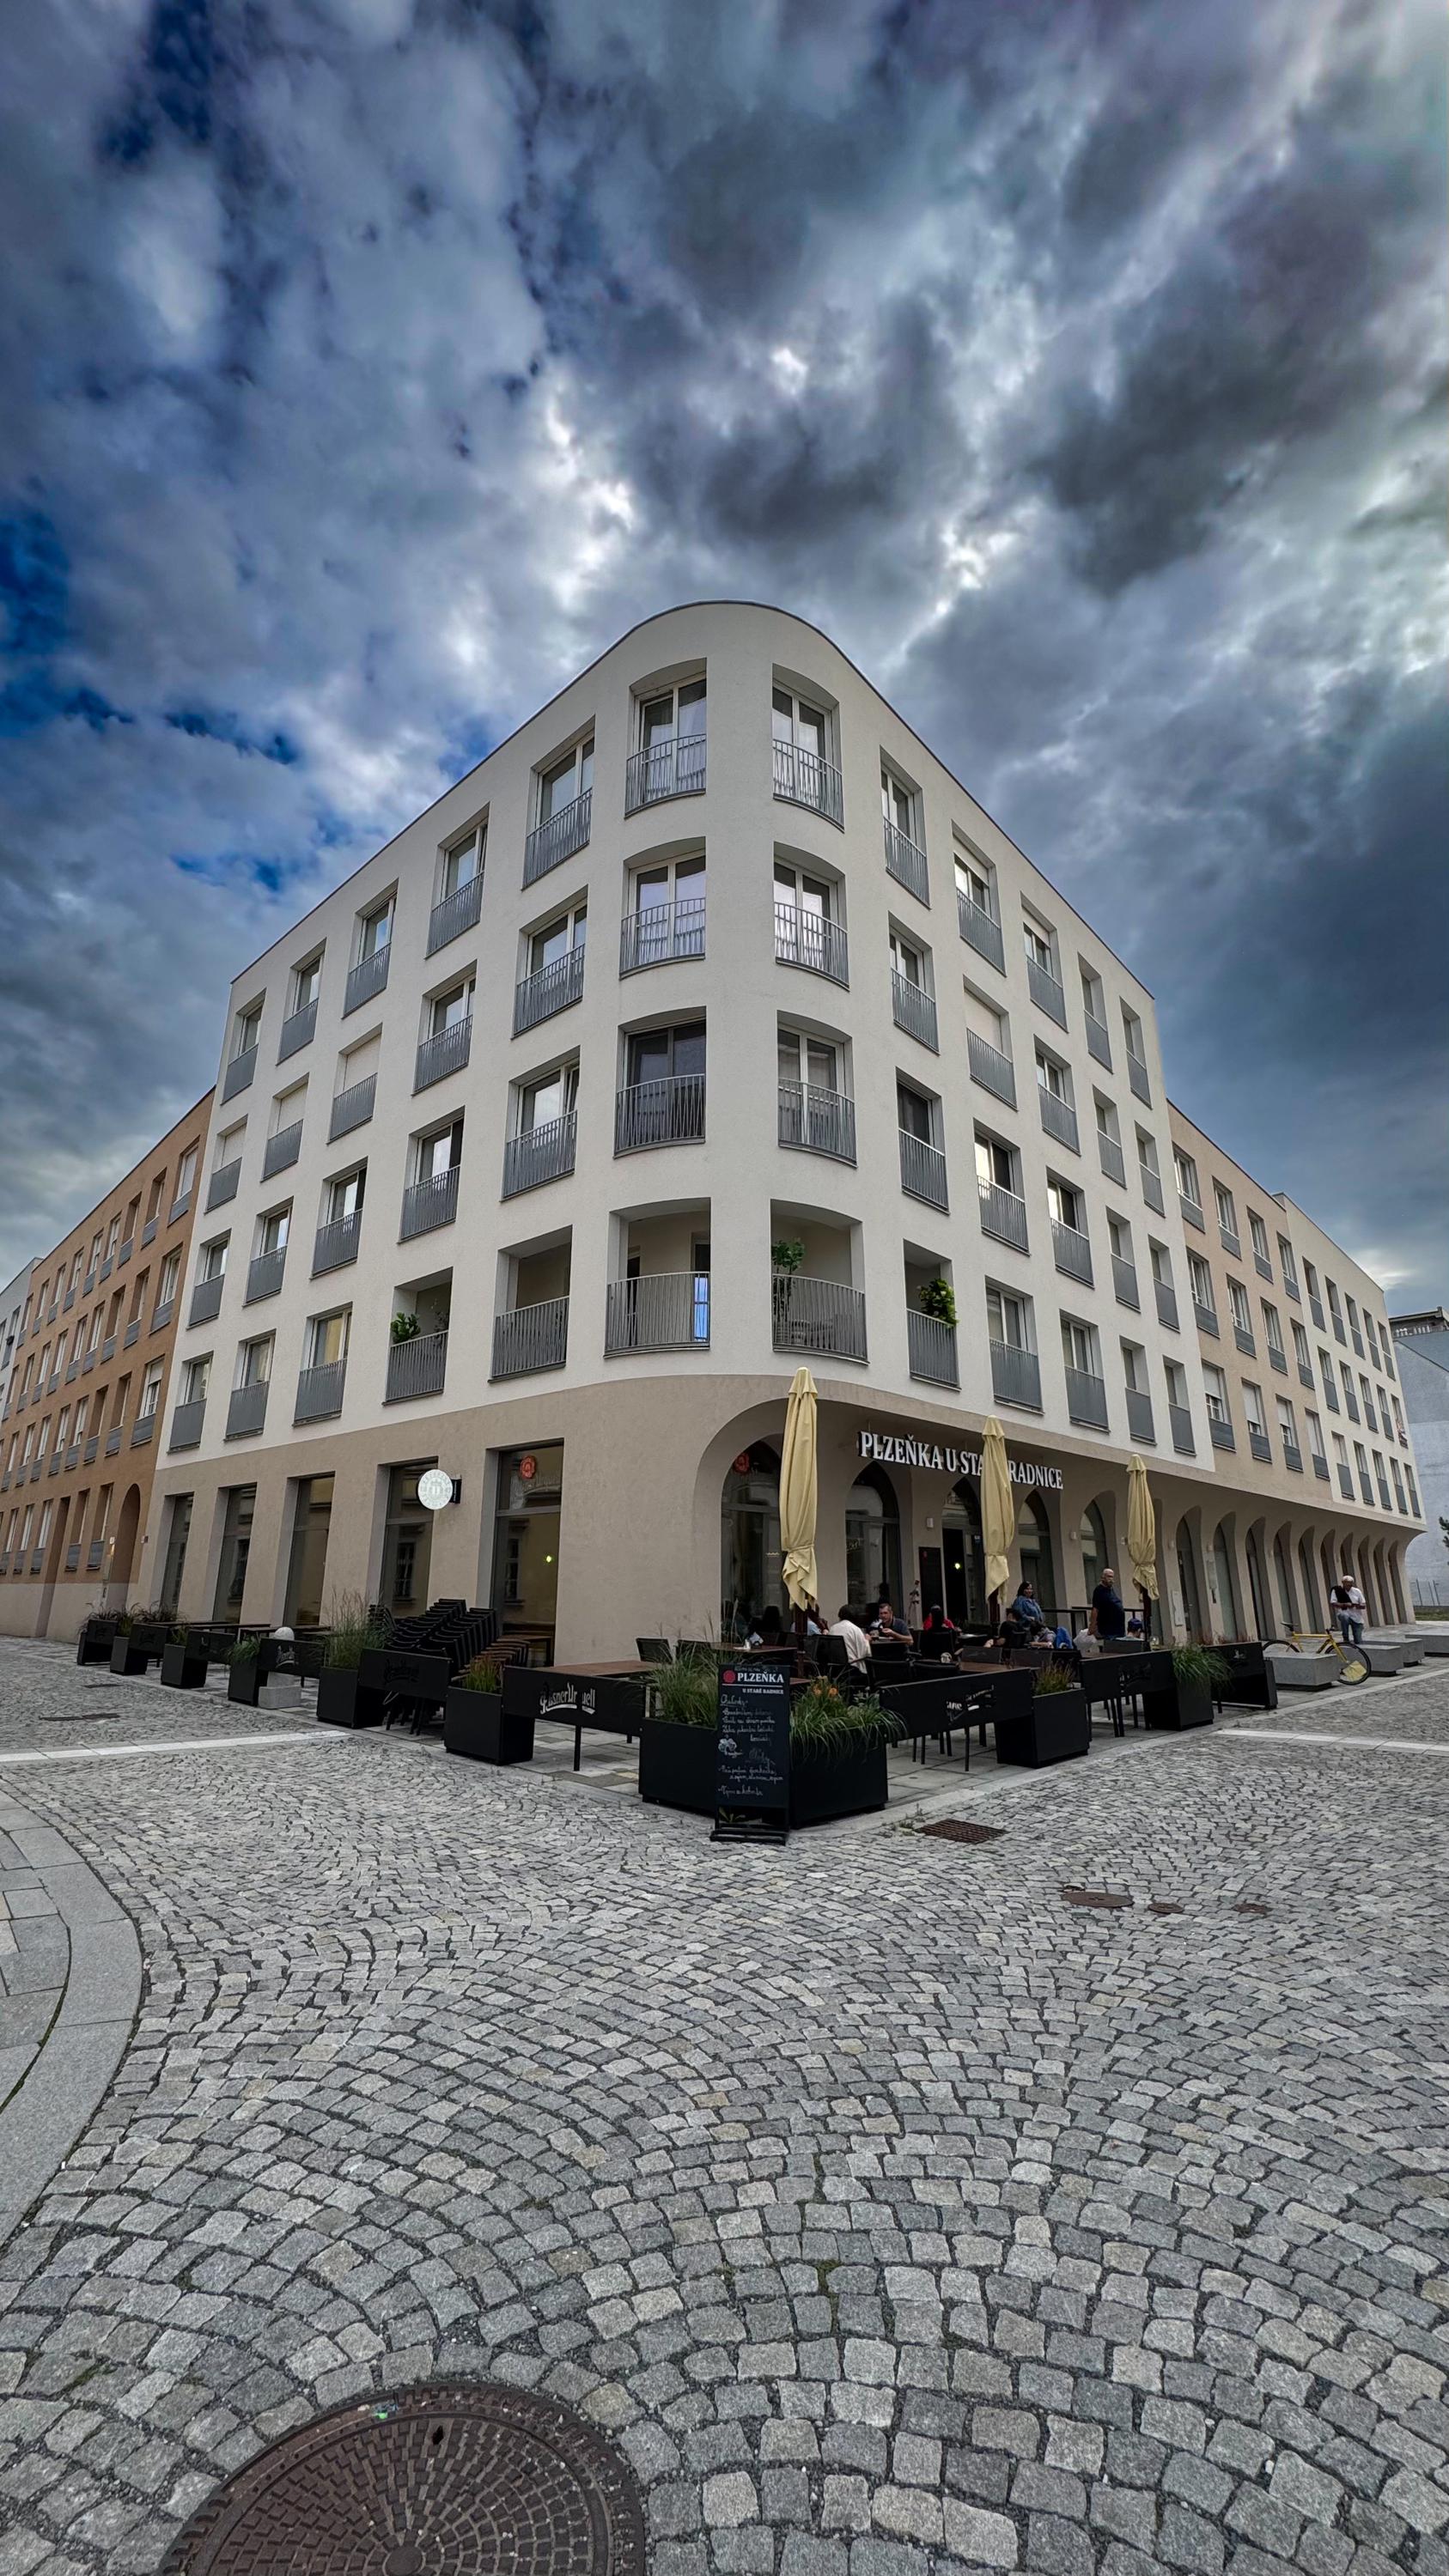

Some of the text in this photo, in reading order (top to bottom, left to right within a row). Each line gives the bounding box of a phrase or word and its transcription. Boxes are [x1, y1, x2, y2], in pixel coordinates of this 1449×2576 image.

[860, 1431, 943, 1470] PLZEŇKA
[945, 1448, 957, 1472] U
[1008, 1460, 1063, 1490] RADNICE
[737, 1671, 784, 1683] PLZEŇKA
